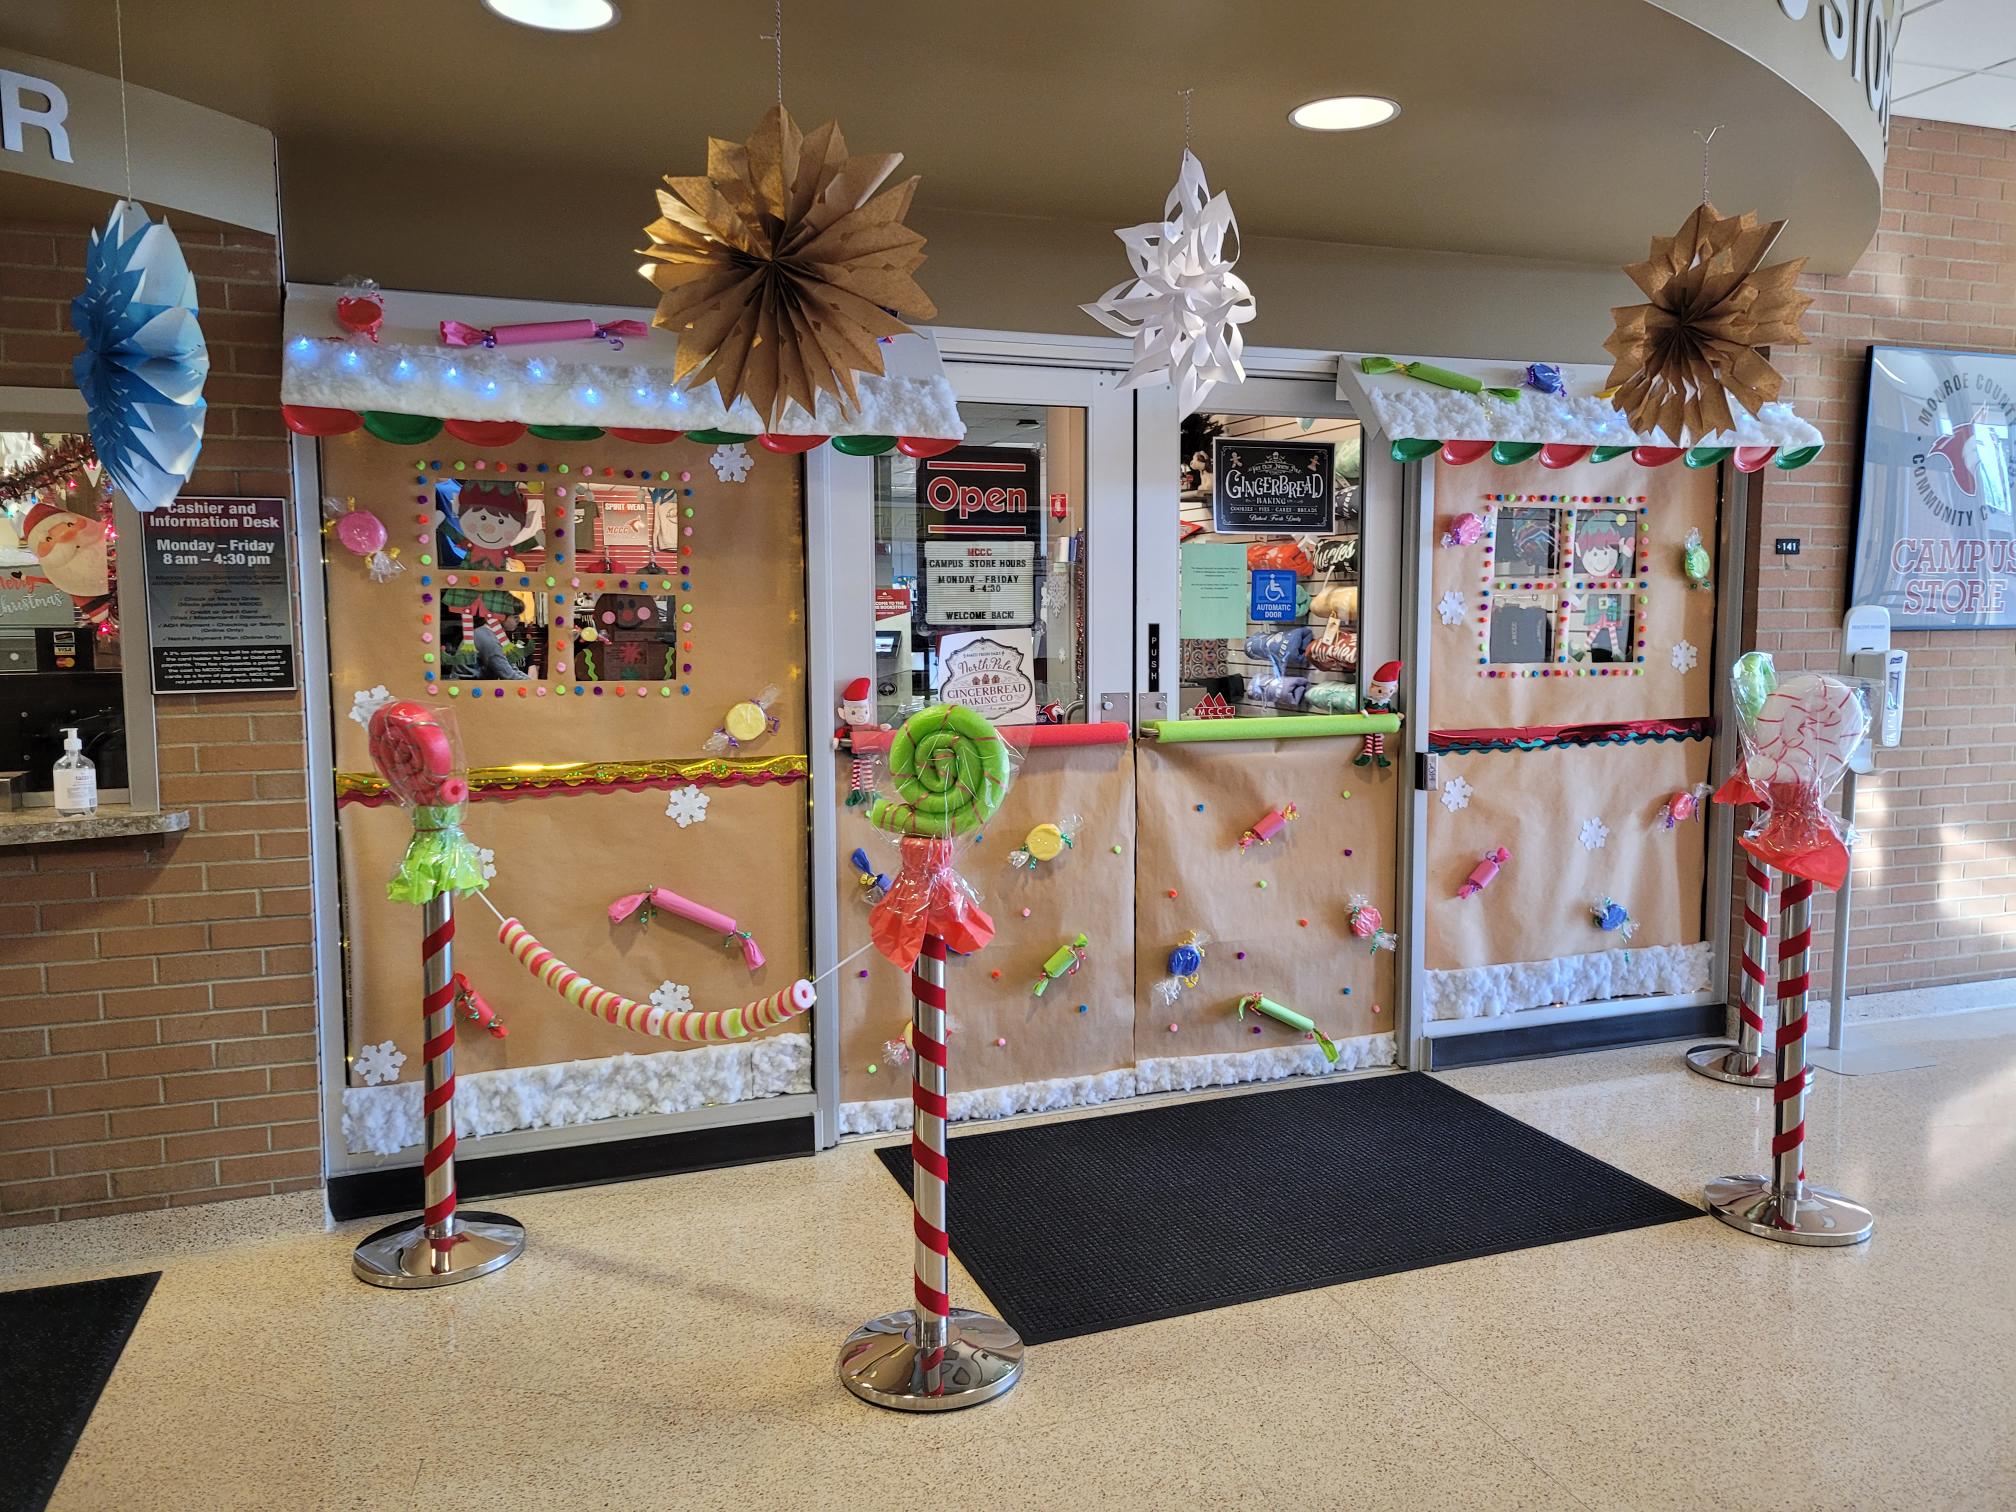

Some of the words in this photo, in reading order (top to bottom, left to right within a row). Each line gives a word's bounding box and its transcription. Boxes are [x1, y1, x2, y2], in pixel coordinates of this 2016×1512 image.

[1918, 373, 1969, 426] MONROE
[1225, 469, 1323, 499] GINGERBREAD
[1912, 453, 1973, 526] COMMUNITY
[927, 476, 1027, 519] Open
[168, 502, 224, 514] Cashier
[228, 502, 257, 515] and
[150, 515, 238, 528] Information
[243, 516, 280, 528] Desk
[156, 539, 215, 553] Monday
[229, 539, 275, 554] Friday
[967, 547, 993, 557] MCCC
[1782, 542, 1796, 551] 141
[163, 553, 173, 565] 8
[175, 555, 199, 565] am
[213, 553, 245, 565] 4:30
[247, 555, 271, 567] pm
[929, 560, 964, 568] CAMPUS
[969, 559, 996, 568] STORE
[999, 559, 1027, 568] HOURS
[937, 575, 975, 584] MONDAY
[985, 575, 1019, 584] FRIDAY
[1903, 579, 2008, 615] STORE
[1256, 603, 1292, 611] AUTOMATIC
[946, 611, 986, 620] WELCOME
[991, 610, 1015, 619] BACK!
[958, 657, 991, 675] North
[991, 656, 1012, 672] Pole
[947, 683, 1026, 699] GINGERBREAD
[962, 696, 998, 706] BAKING
[1000, 694, 1013, 702] CO
[1198, 707, 1231, 715] MCCC
